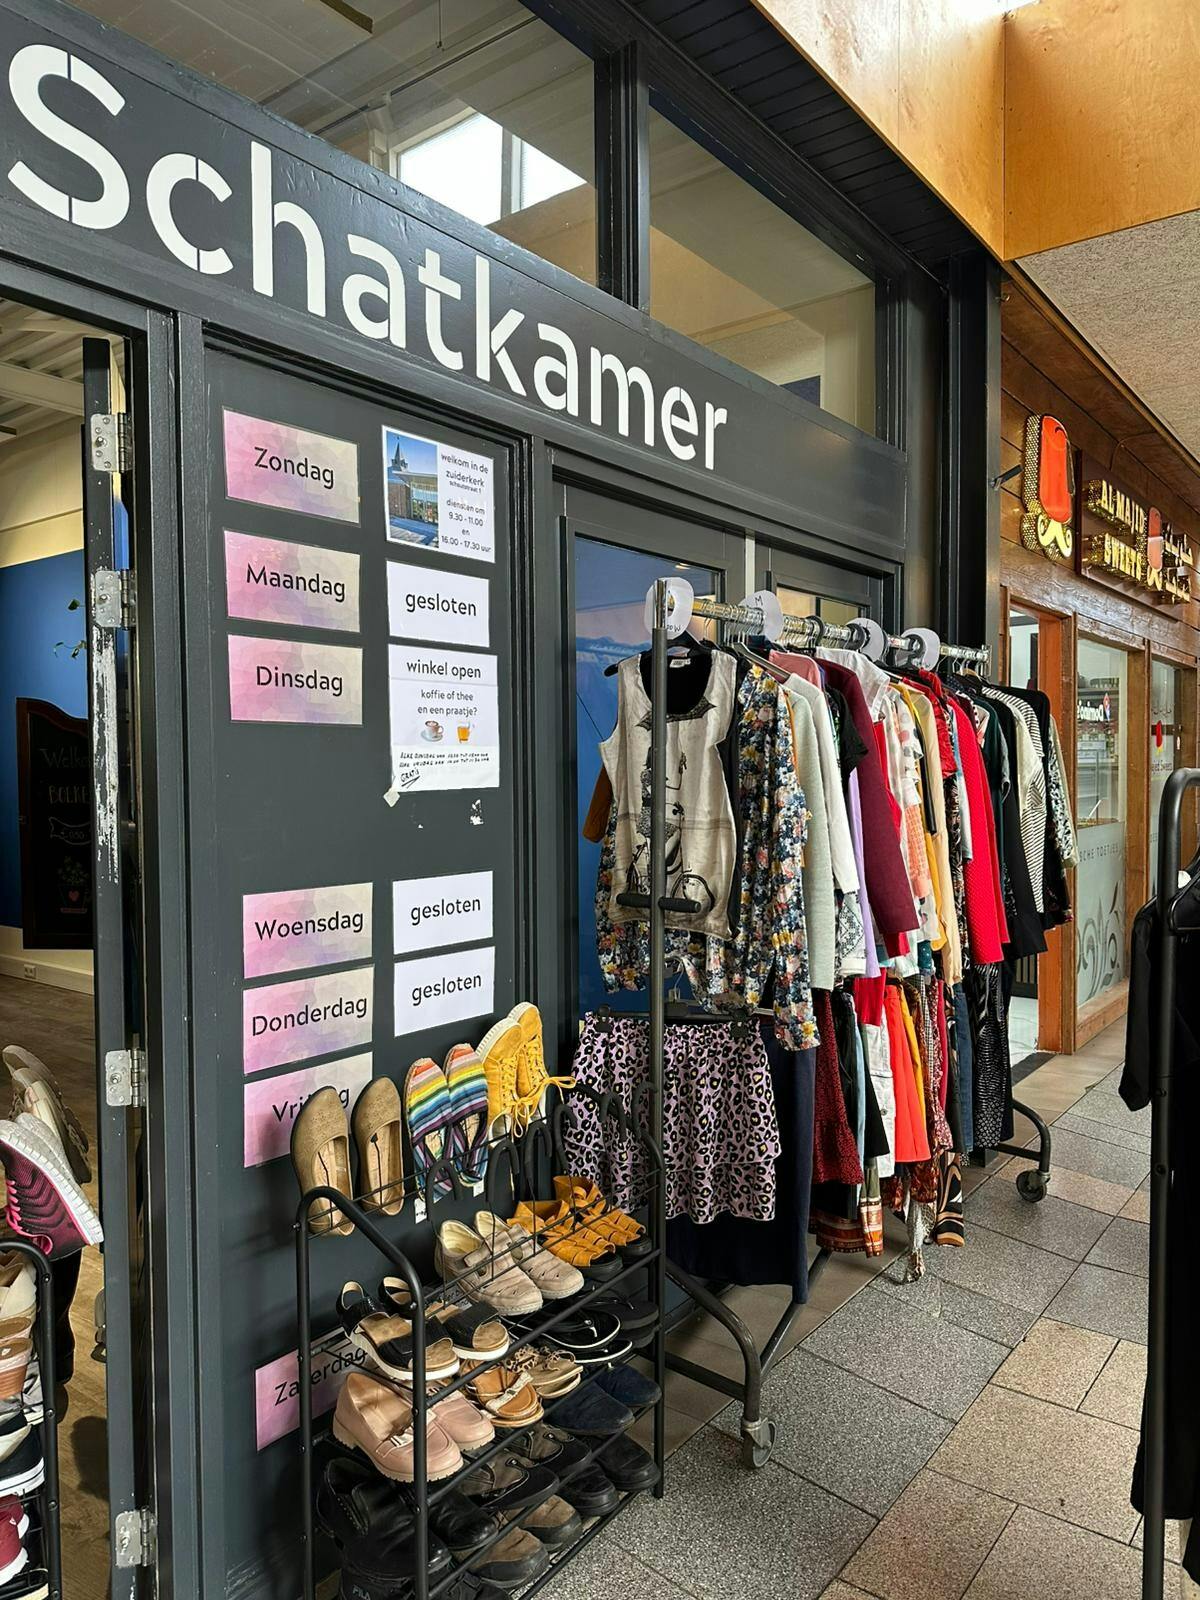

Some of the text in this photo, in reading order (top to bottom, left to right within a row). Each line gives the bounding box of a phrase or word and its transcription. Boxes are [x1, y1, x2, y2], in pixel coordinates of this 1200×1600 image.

[8, 44, 728, 470] Schatkamer
[253, 446, 335, 489] Zondag
[441, 453, 488, 474] welkom in de
[446, 470, 484, 487] zuiderkerk
[446, 499, 485, 515] diensten om
[449, 511, 463, 522] 9.30
[468, 516, 484, 526] 11.00
[1101, 479, 1145, 535] AL MAJID
[462, 528, 470, 536] en
[464, 541, 480, 551] 17.30
[481, 545, 491, 553] uur
[1103, 532, 1142, 581] SWEETS
[246, 562, 346, 603] Maandag
[405, 593, 477, 616] gesloten
[256, 665, 343, 697] Dinsdag
[406, 659, 482, 680] winkel open
[421, 690, 474, 701] koffie of thee
[417, 706, 478, 717] en een praatje?
[40, 746, 89, 768] Welko
[48, 785, 89, 804] BOEKE
[410, 896, 481, 925] gesloten
[255, 910, 364, 940] Woensdag
[411, 973, 482, 1006] gesloten
[252, 997, 368, 1036] Donderdag
[272, 1088, 350, 1122] Vrig
[274, 1347, 368, 1407] Zaerdag
